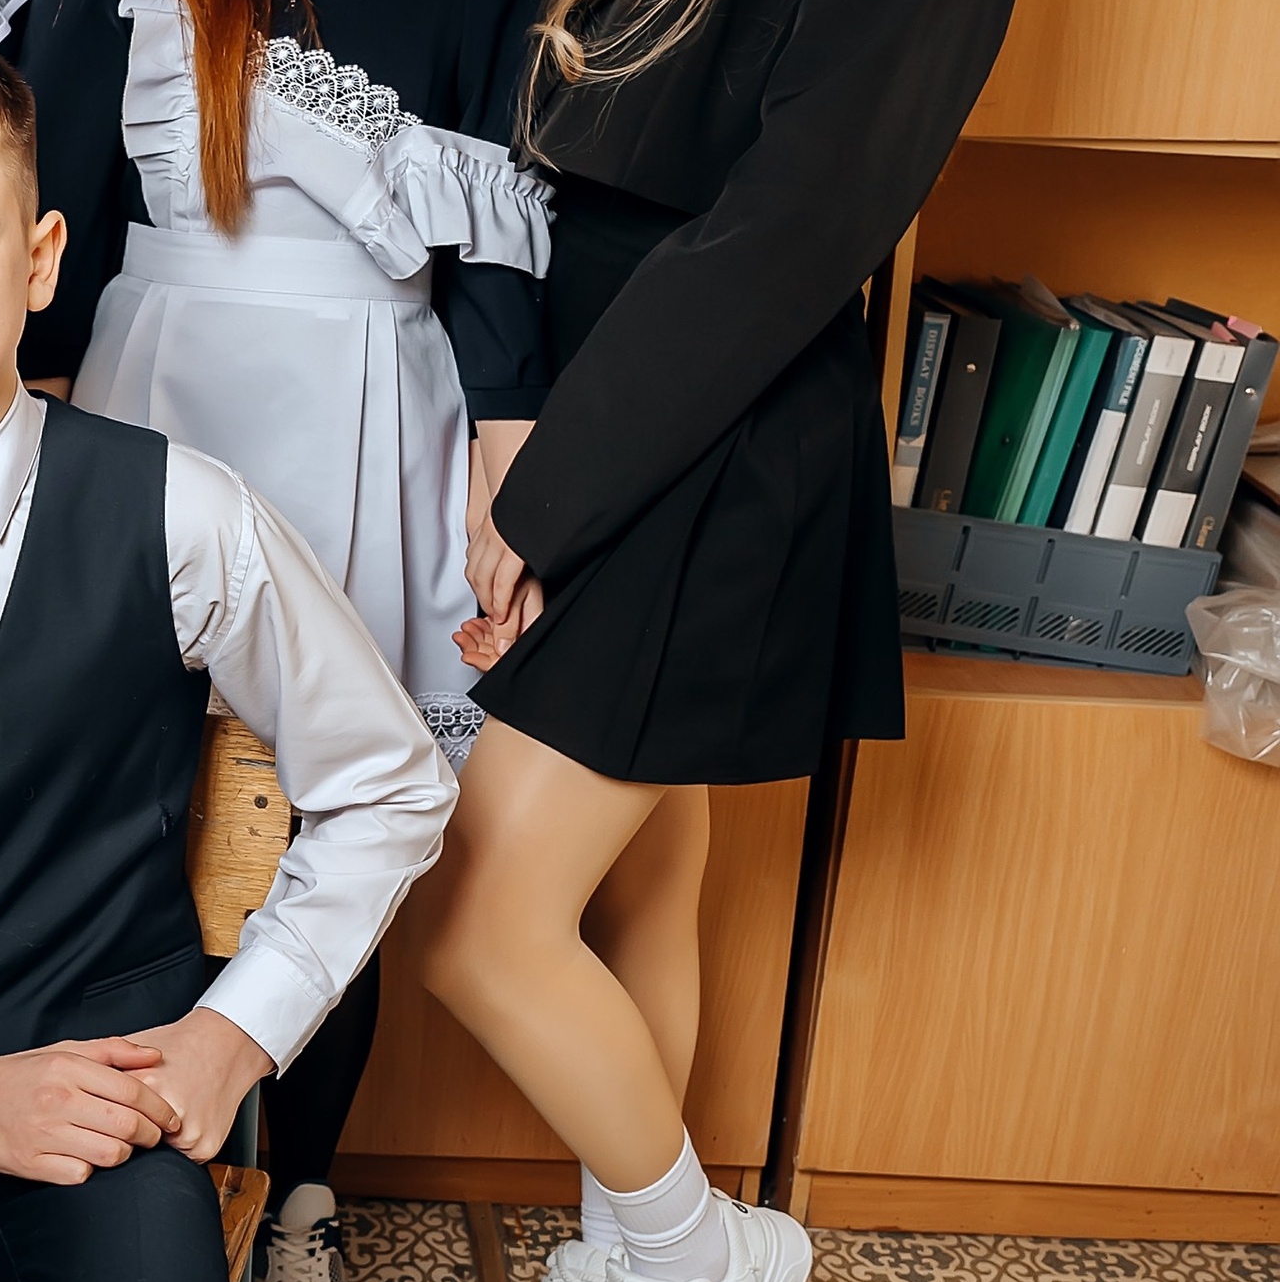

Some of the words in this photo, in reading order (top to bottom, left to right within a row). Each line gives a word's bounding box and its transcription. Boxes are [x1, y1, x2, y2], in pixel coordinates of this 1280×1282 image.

[920, 328, 939, 379] DISPLAY
[909, 386, 927, 427] BOOKS
[1118, 384, 1133, 407] FILE
